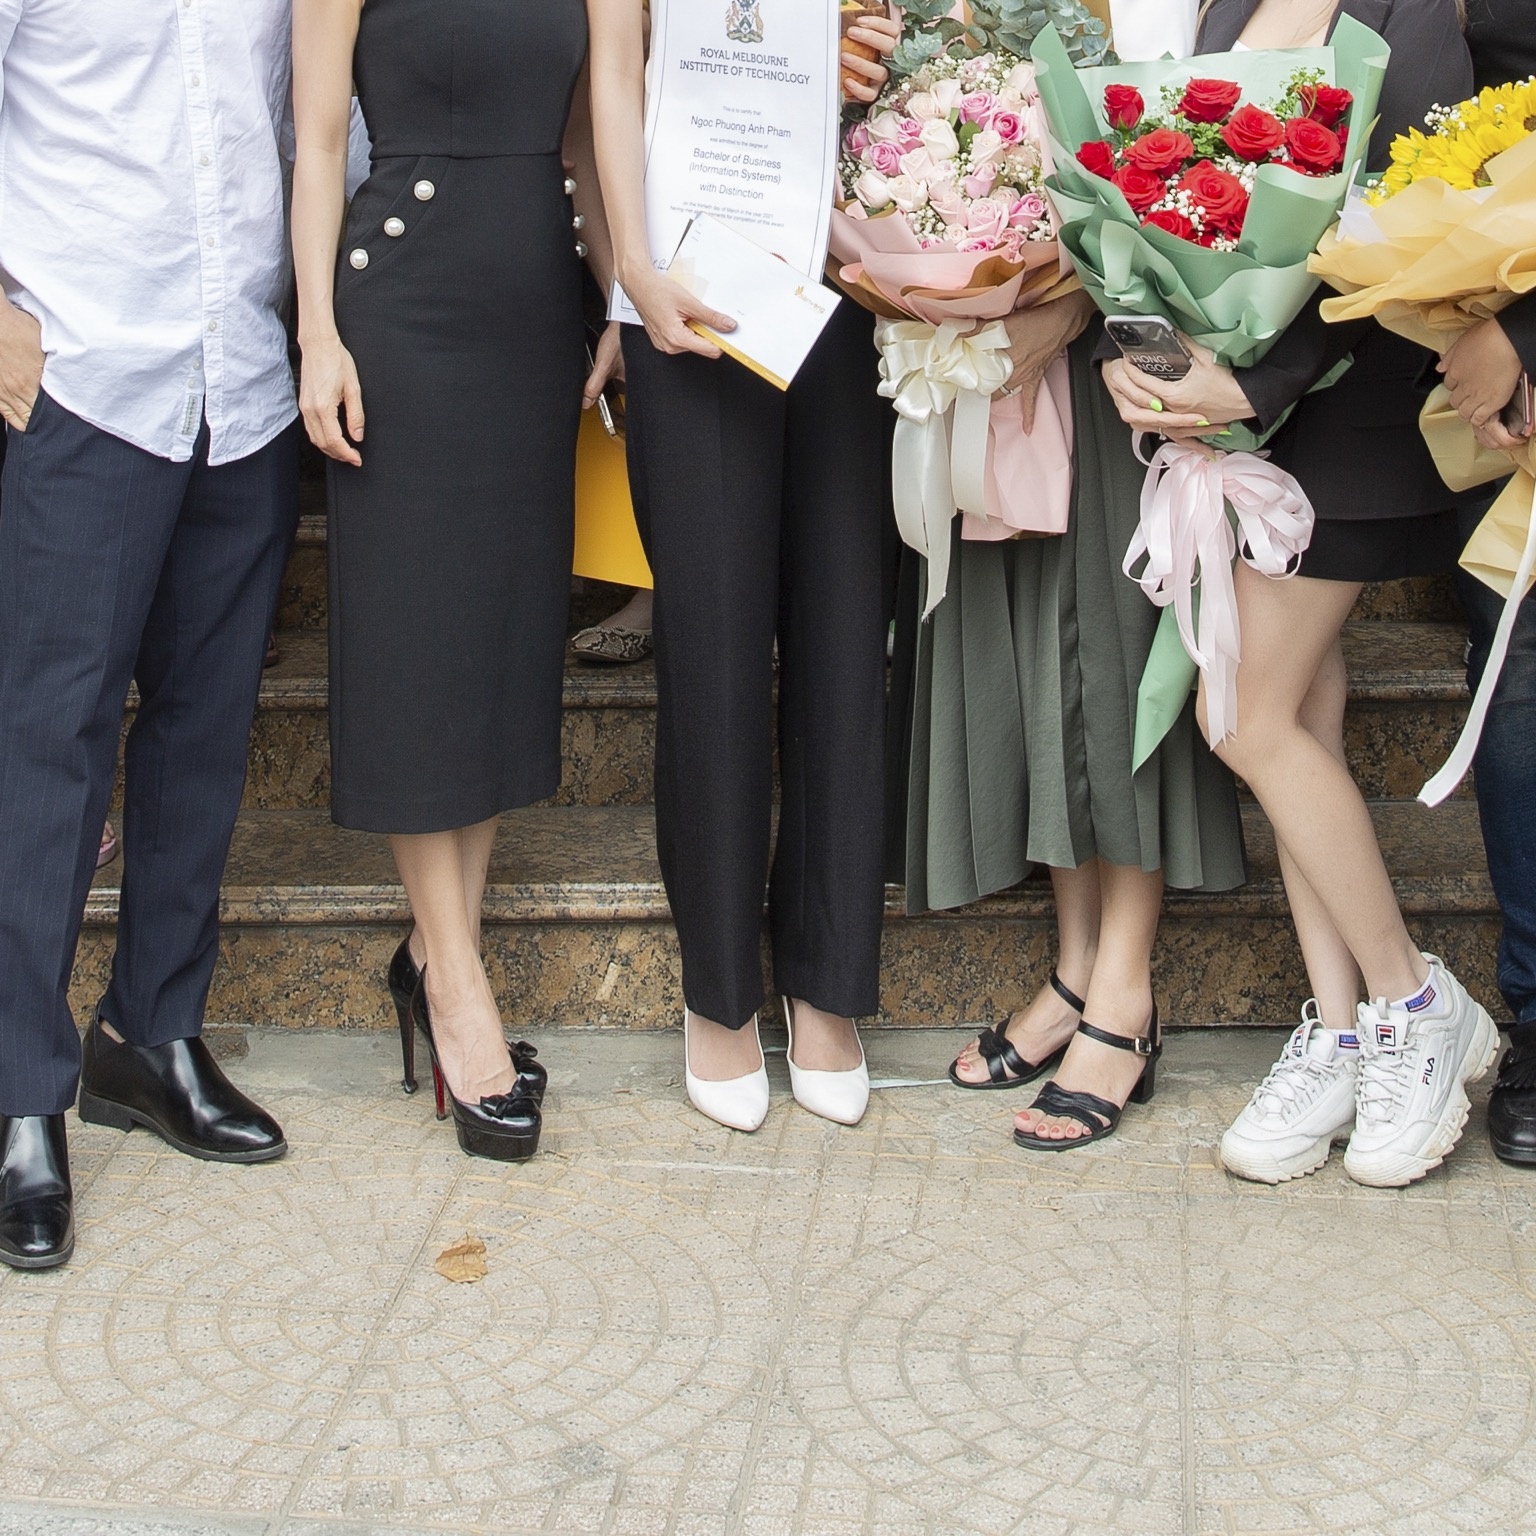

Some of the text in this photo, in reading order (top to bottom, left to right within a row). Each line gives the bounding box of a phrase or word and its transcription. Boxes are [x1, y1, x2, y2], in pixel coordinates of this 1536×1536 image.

[700, 47, 789, 67] ROYAL MELBOURNE
[680, 60, 810, 84] INSTITUTE OF TECHNOLOGY
[691, 116, 791, 138] Ngoc Phuong Anh Pham
[693, 147, 781, 170] Bachelor of Business
[689, 162, 781, 184] (Information Systems)
[699, 182, 764, 200] with Distinction
[1131, 355, 1168, 364] HONG
[1137, 364, 1174, 372] NGOC
[1422, 1057, 1435, 1085] FILA
